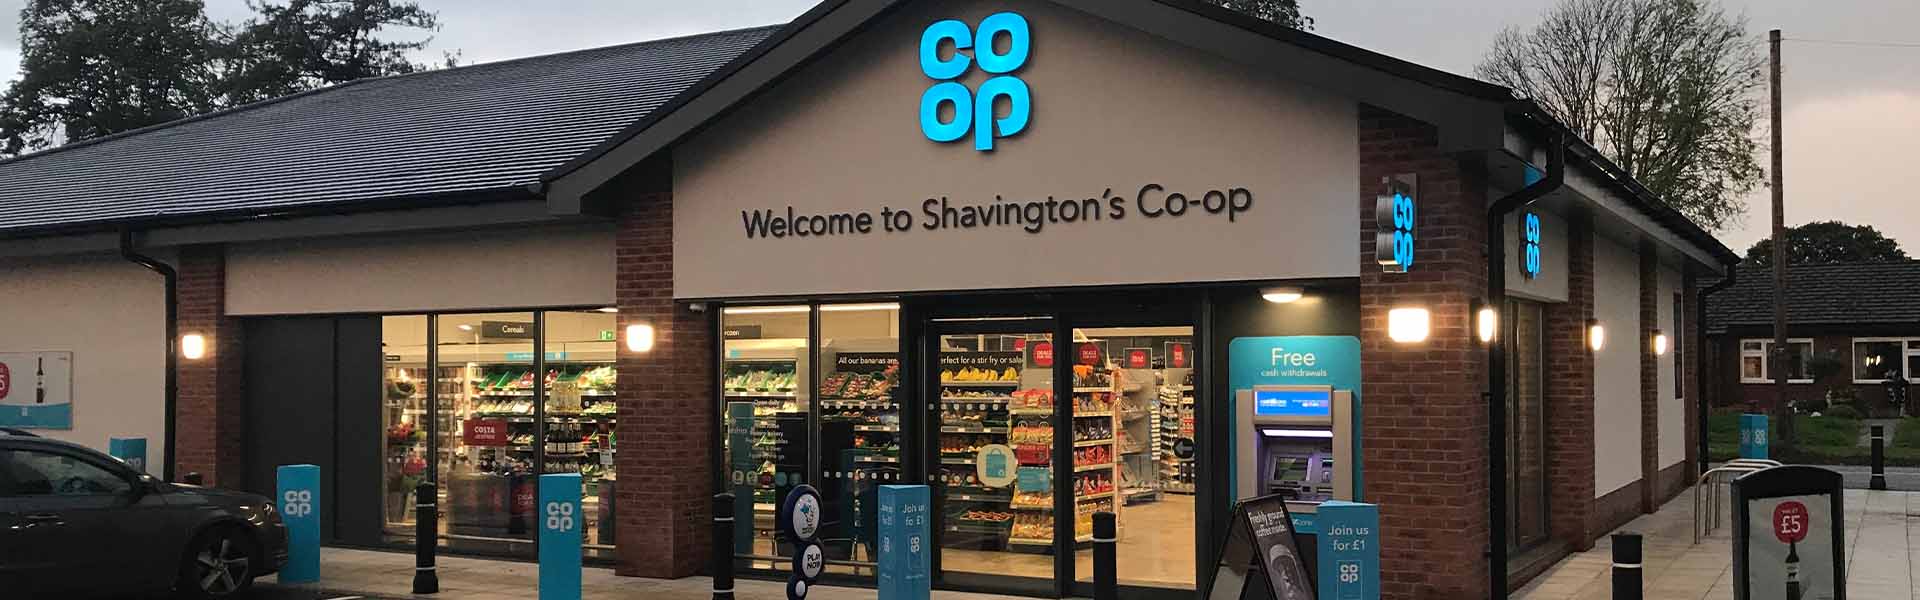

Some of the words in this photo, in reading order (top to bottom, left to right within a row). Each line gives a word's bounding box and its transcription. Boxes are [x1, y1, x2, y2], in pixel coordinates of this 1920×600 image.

[742, 206, 873, 239] Welcome
[881, 206, 912, 233] to
[1136, 183, 1253, 224] Co-op
[838, 356, 848, 365] All
[940, 355, 960, 364] erfect
[960, 355, 969, 364] for
[977, 356, 988, 364] stir
[989, 355, 999, 366] fry
[1008, 356, 1023, 364] sala
[1271, 346, 1316, 367] Free
[1260, 368, 1279, 377] cash
[1280, 368, 1328, 377] withdrawals
[474, 426, 496, 434] COSTA
[1248, 511, 1269, 526] Freshly
[1781, 515, 1801, 534] £5
[1327, 524, 1353, 536] Join
[1355, 527, 1369, 535] us
[1333, 539, 1350, 551] for
[1352, 539, 1365, 551] £1
